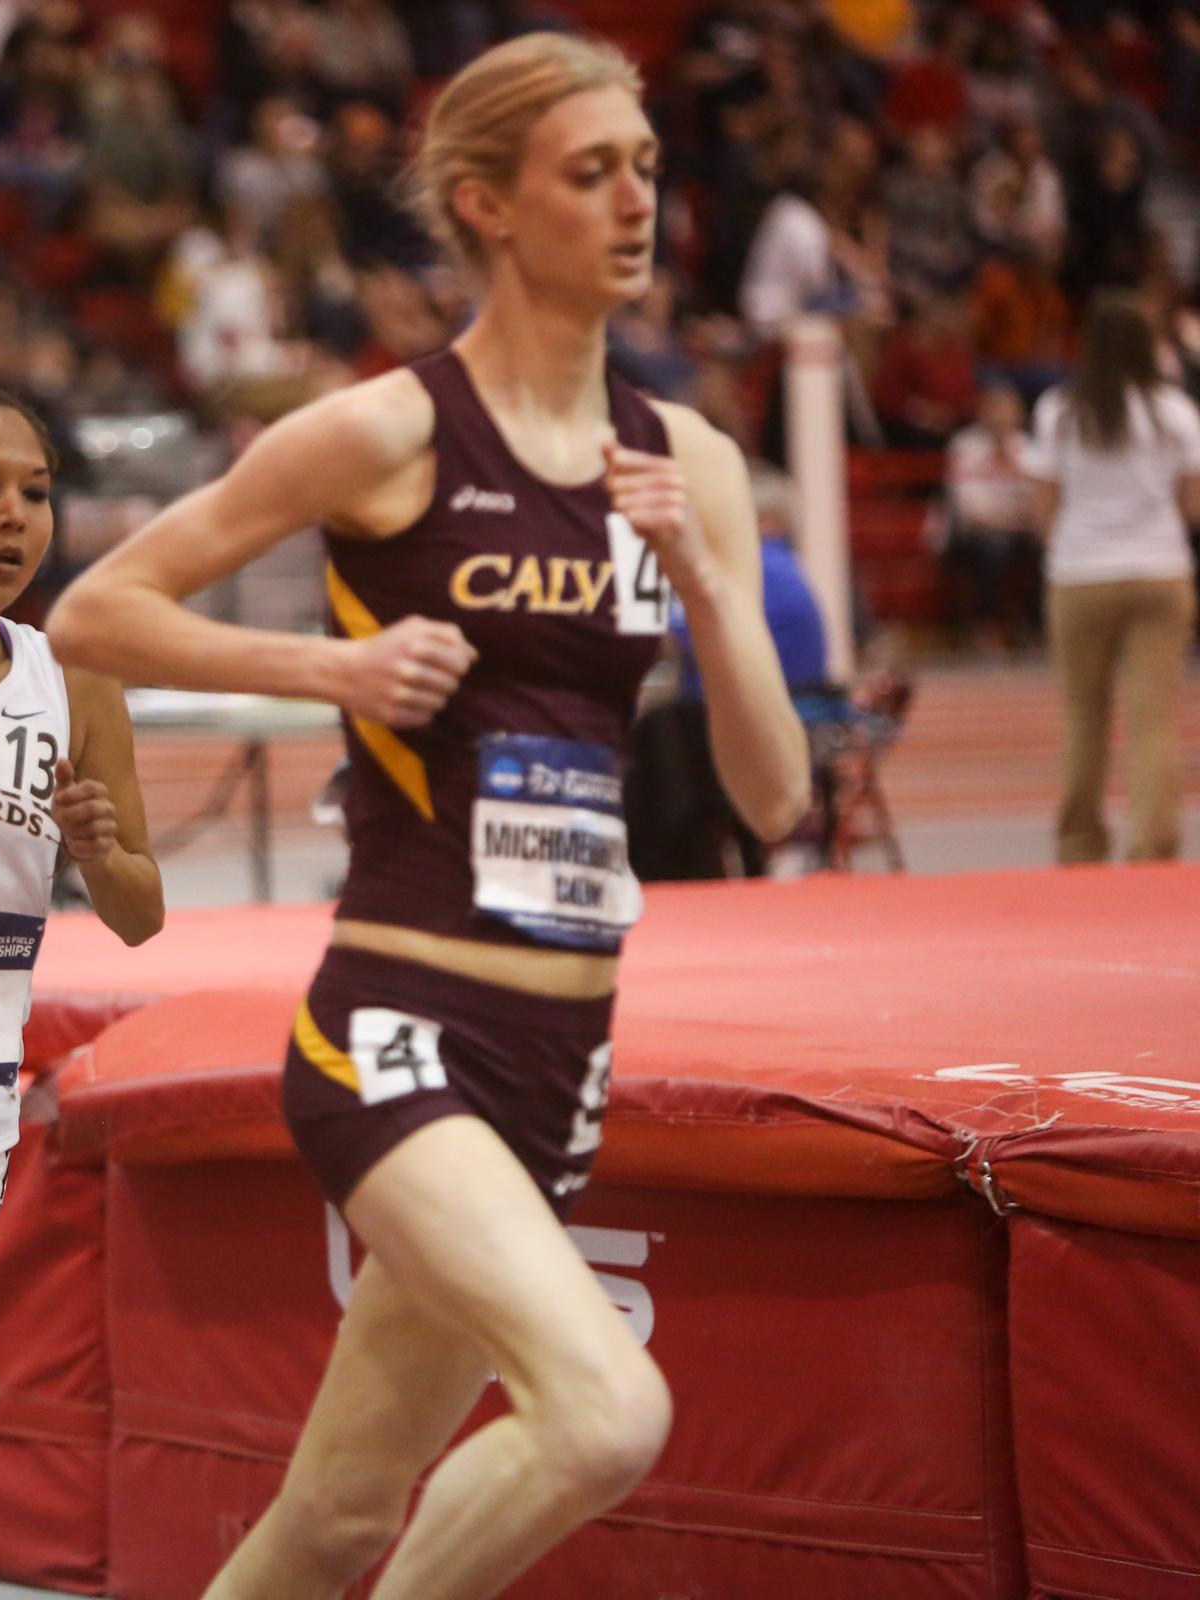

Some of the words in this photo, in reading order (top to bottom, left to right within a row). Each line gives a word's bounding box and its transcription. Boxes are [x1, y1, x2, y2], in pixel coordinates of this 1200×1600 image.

[451, 553, 618, 616] CALV
[635, 545, 664, 625] 4
[5, 725, 59, 801] 13
[11, 936, 36, 946] FIELD
[377, 1023, 424, 1089] 4
